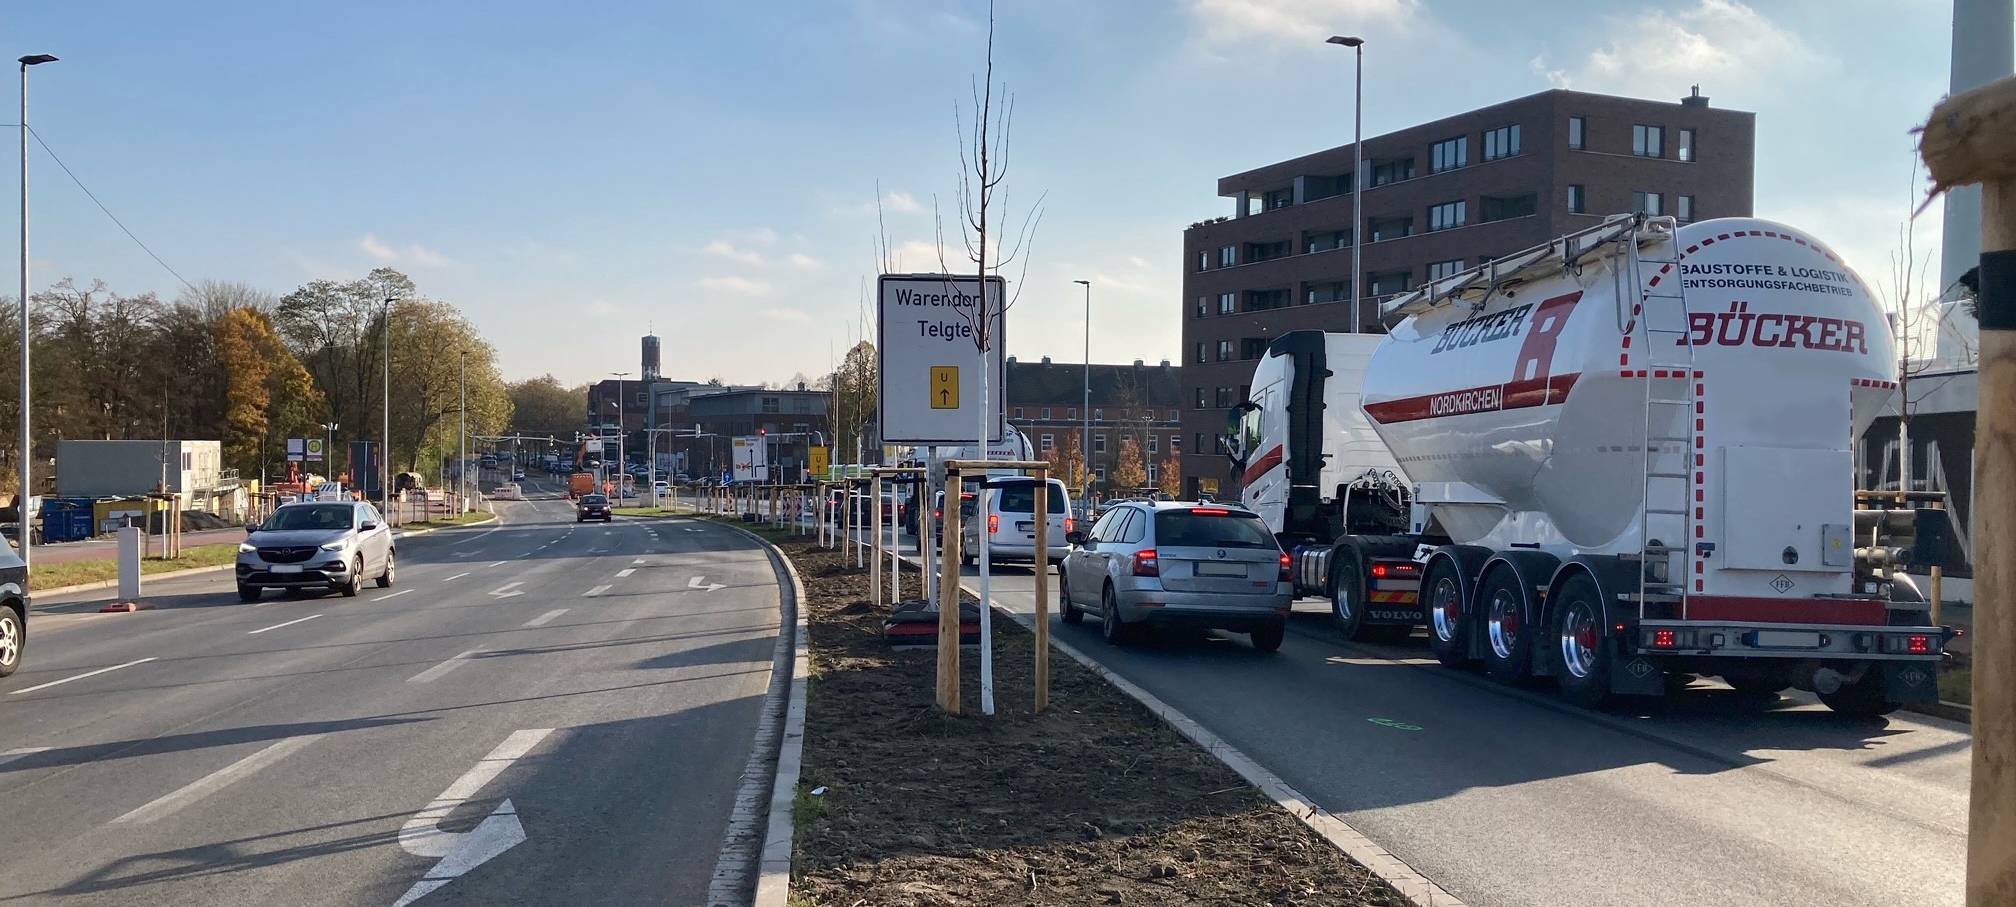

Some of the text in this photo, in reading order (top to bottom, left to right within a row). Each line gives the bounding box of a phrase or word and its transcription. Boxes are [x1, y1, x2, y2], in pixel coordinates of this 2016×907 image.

[1680, 264, 1849, 284] BAUSTOFFE & LOGISTIK
[1683, 278, 1853, 297] ENTSORGUNGSFACHBETRIEB
[896, 288, 985, 308] Warendor
[917, 320, 971, 342] Telgte
[1430, 303, 1535, 355] BÜCKER
[1675, 301, 1868, 355] BÜCKER
[940, 372, 948, 383] U
[1430, 388, 1500, 416] NORDKIRCHEN
[1369, 610, 1423, 620] VOLVO
